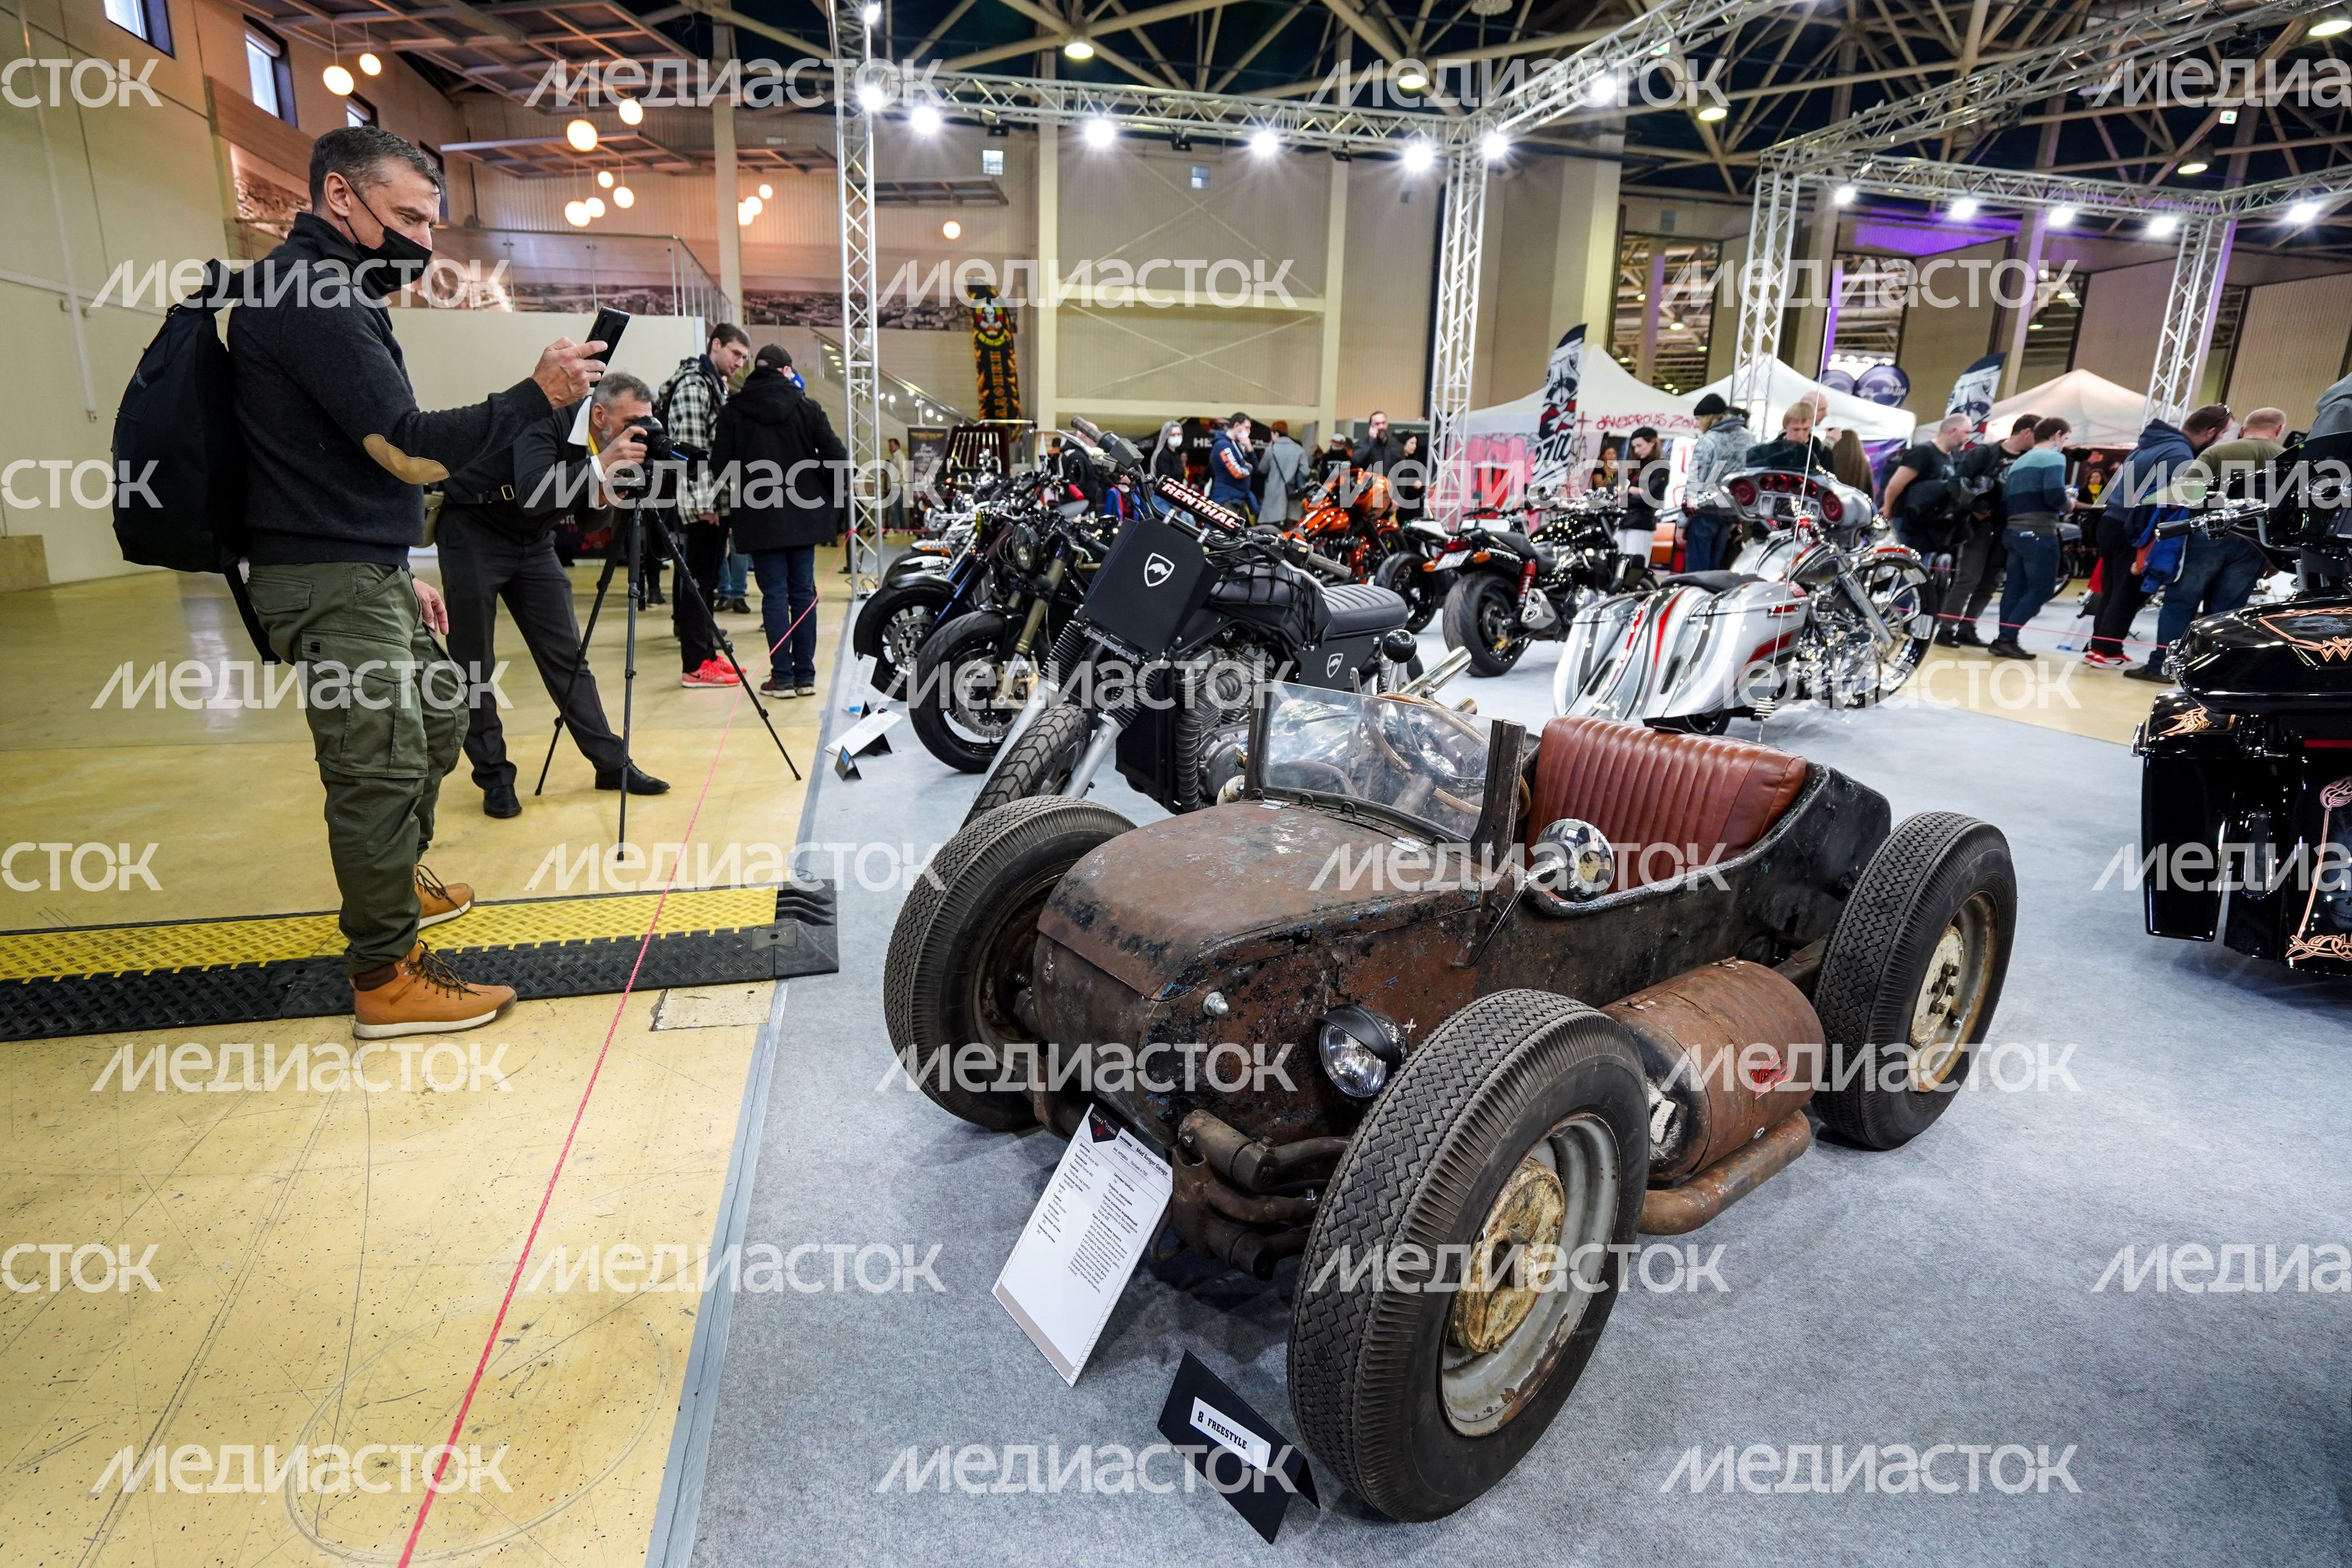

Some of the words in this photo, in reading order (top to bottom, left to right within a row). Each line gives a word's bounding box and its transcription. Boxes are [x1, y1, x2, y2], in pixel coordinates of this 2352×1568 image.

[1161, 482, 1236, 529] RENTHAL
[1135, 1147, 1144, 1156] Mad
[1143, 1153, 1156, 1167] Badger
[1155, 1163, 1168, 1177] Garage
[1197, 1410, 1204, 1424] 8
[1208, 1418, 1248, 1450] FREESTYLE
